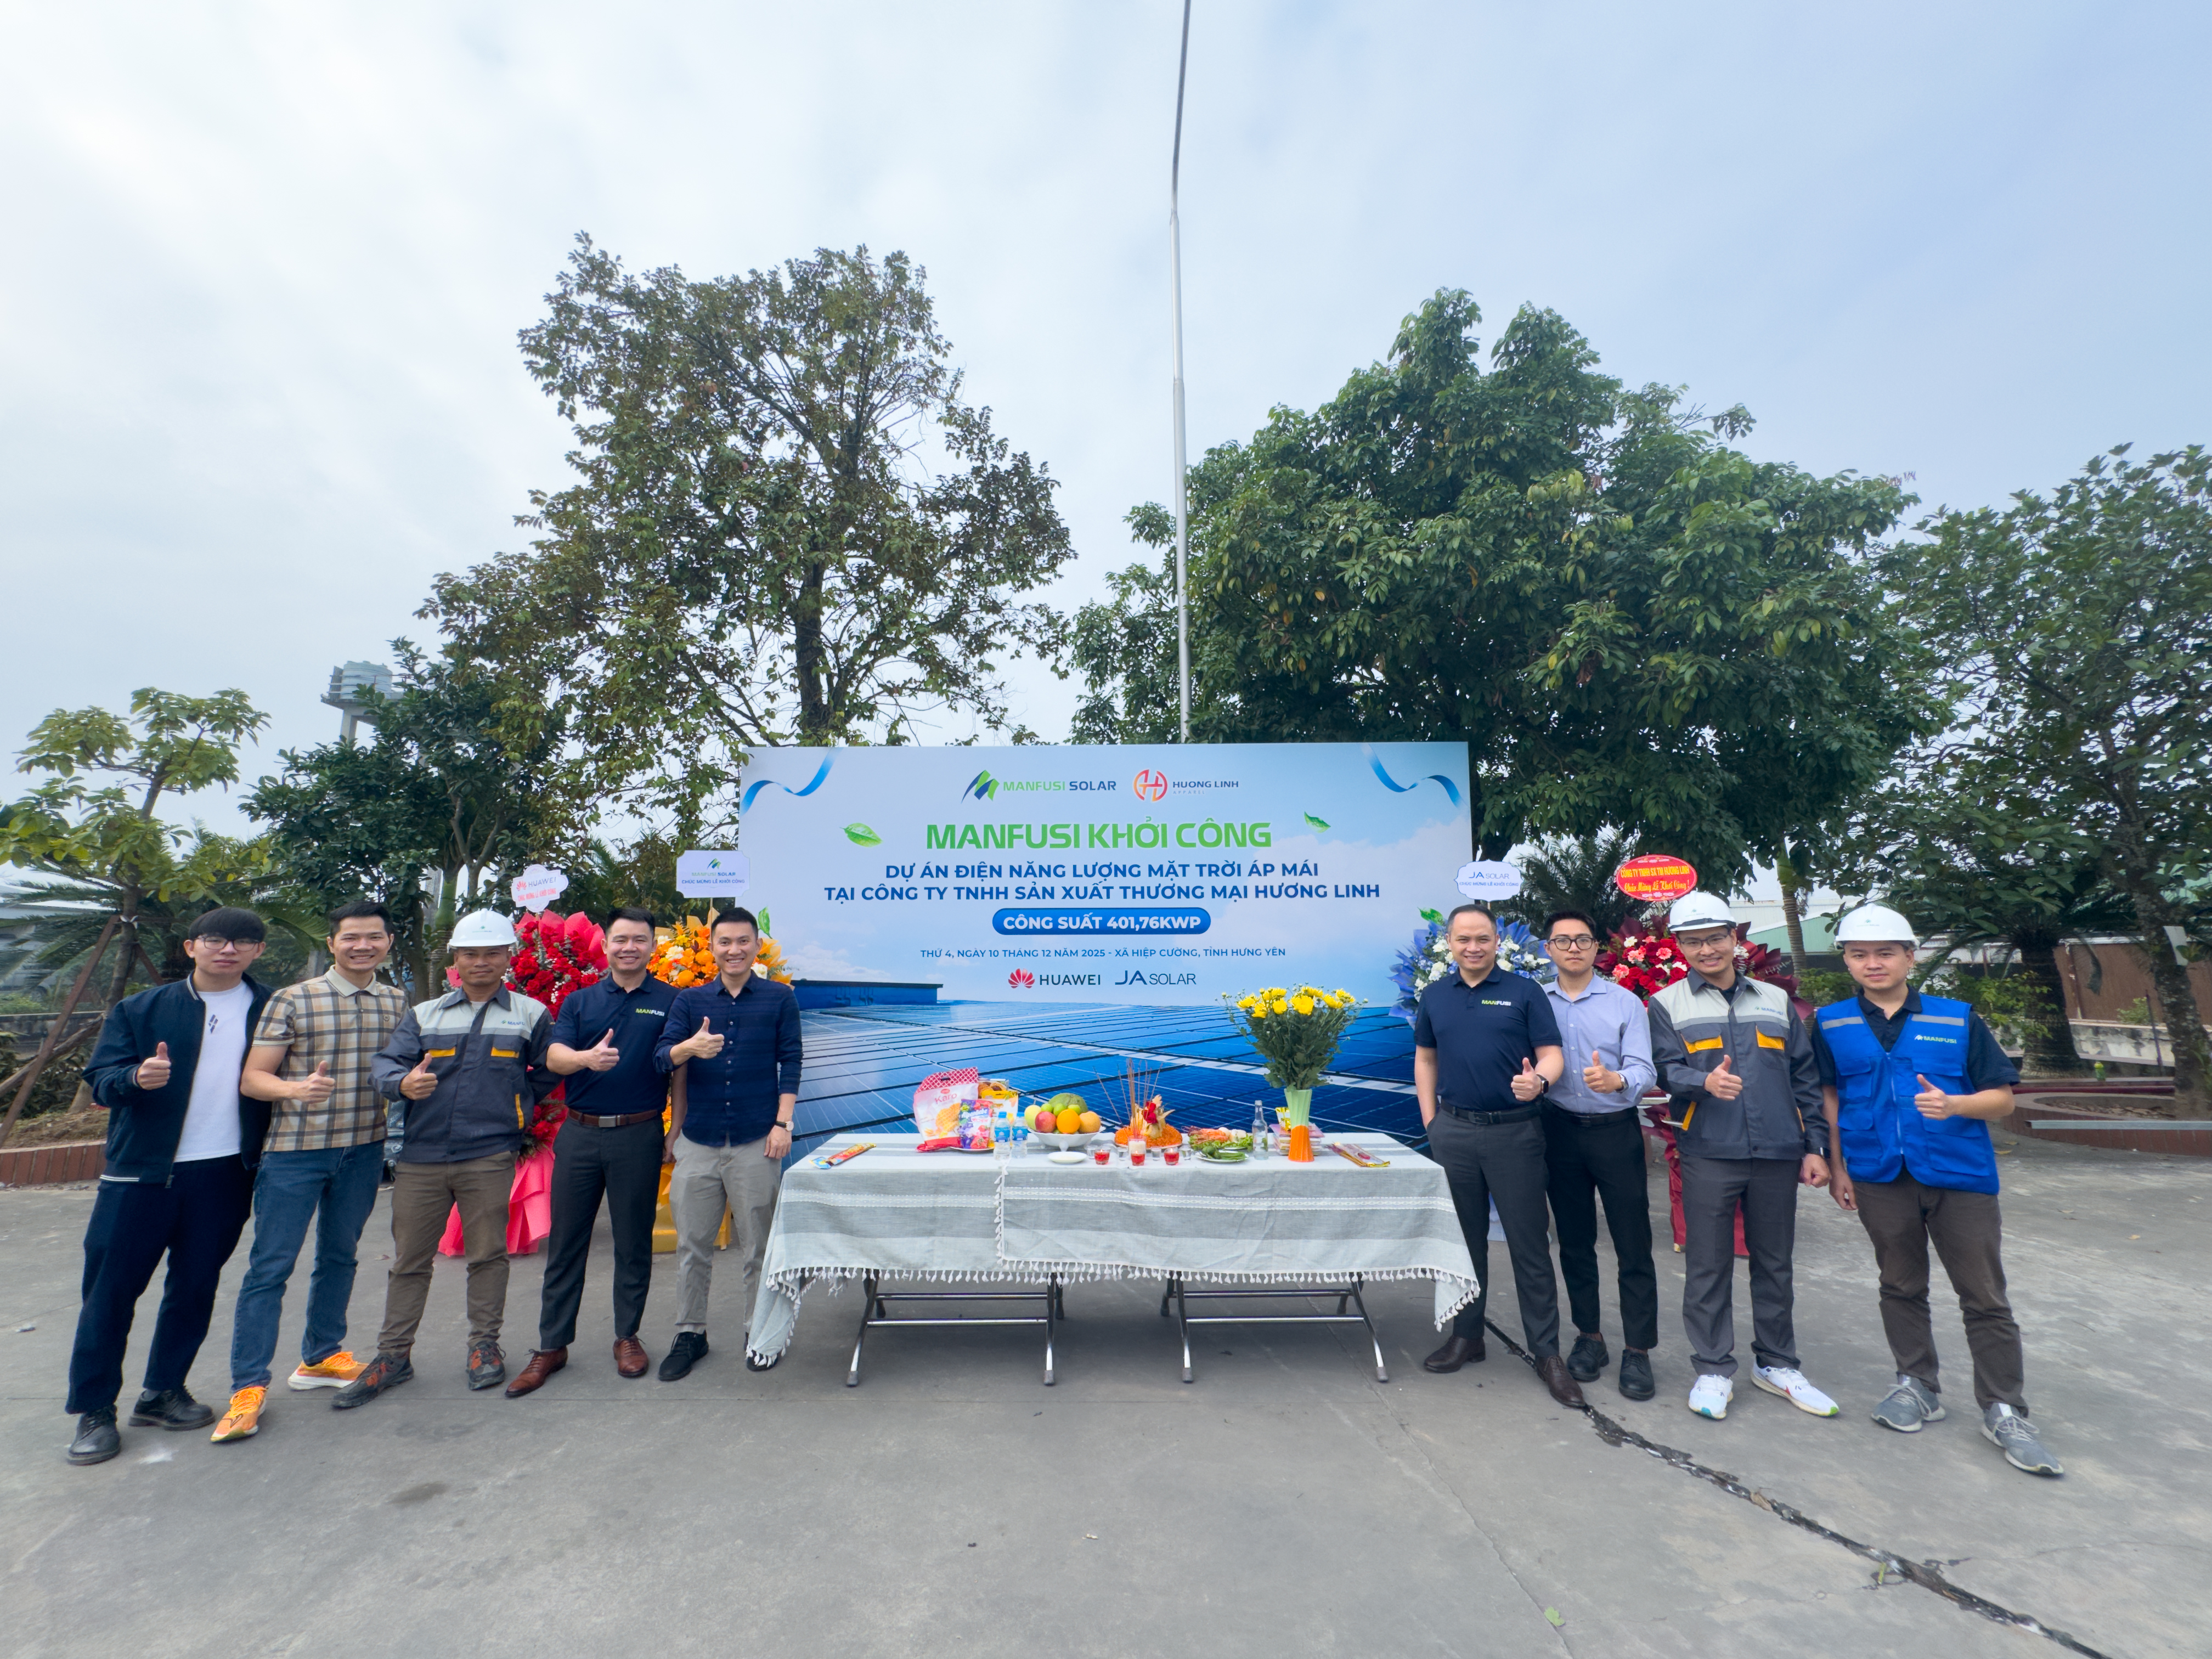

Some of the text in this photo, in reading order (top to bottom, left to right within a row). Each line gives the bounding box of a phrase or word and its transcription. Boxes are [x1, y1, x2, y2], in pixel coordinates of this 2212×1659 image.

[1003, 781, 1116, 791] MANFUSI SOLAR
[927, 816, 1271, 849] MANFUSI KHỞI CÔNG
[886, 859, 1318, 882] DỰ ÁN ĐIỆN NĂNG LƯỢNG MẶT TRỜI ÁP MÁI
[528, 877, 556, 887] HUAWEI
[824, 881, 1379, 904] TẠI CÔNG TY TNHH SẢN XUẤT THƯƠNG MẠI HƯƠNG LINH
[1003, 912, 1201, 931] CÔNG SUẤT 401,76KWP
[921, 948, 943, 957] THỨ
[945, 950, 954, 958] 4,
[957, 948, 986, 957] NGÀY
[1002, 948, 1039, 957] THÁNG
[1054, 947, 1078, 957] NĂM
[1115, 947, 1129, 957] XÃ
[1132, 947, 1156, 958] HIỆP
[1159, 947, 1200, 958] CƯỜNG,
[1203, 946, 1228, 956] TỈNH
[1231, 947, 1261, 956] HƯNG
[1265, 946, 1285, 956] YÊN
[1040, 974, 1101, 985] HUAWEI
[935, 1093, 957, 1104] Karo
